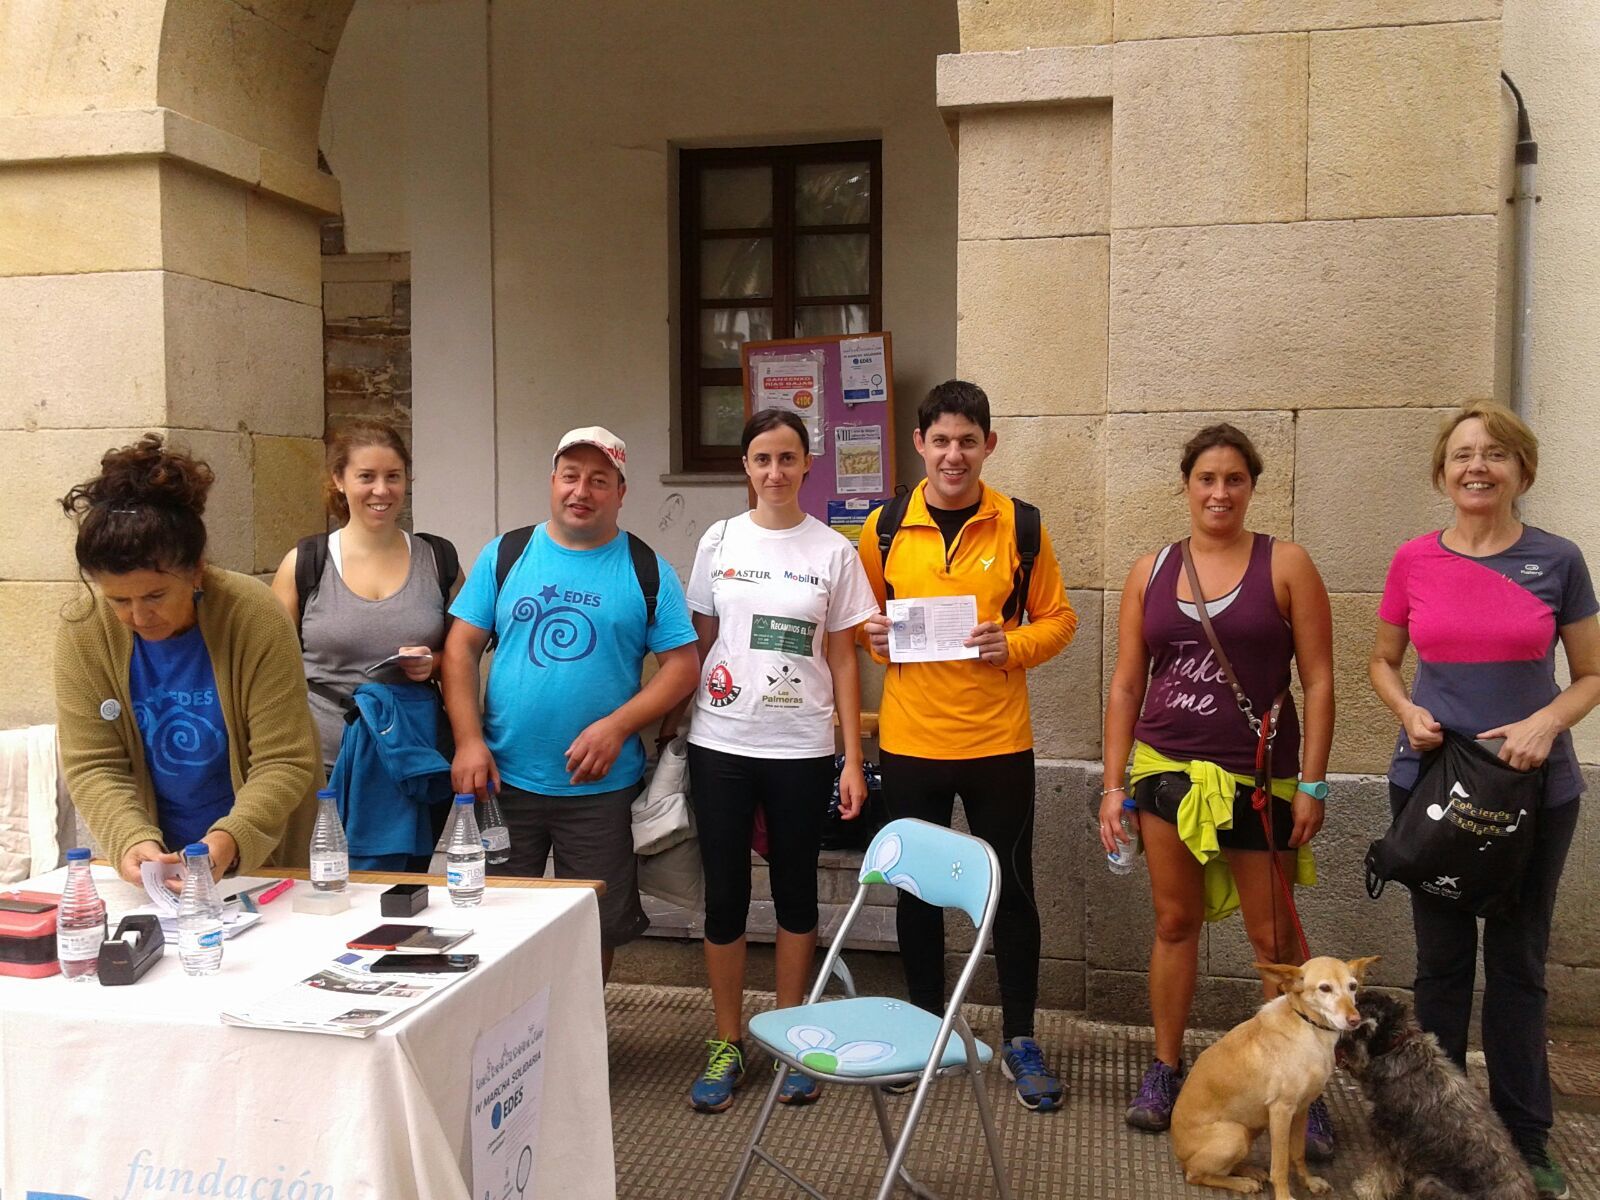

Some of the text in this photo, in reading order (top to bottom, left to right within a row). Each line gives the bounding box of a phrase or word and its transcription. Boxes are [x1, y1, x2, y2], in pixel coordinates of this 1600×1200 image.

[784, 570, 810, 583] Mobil
[563, 590, 602, 608] EDES
[762, 695, 804, 704] Palmeras
[483, 1078, 510, 1110] MARCHA
[511, 1050, 541, 1084] SOLIDARIA
[503, 1085, 524, 1119] EDES
[117, 1149, 335, 1200] fundación
